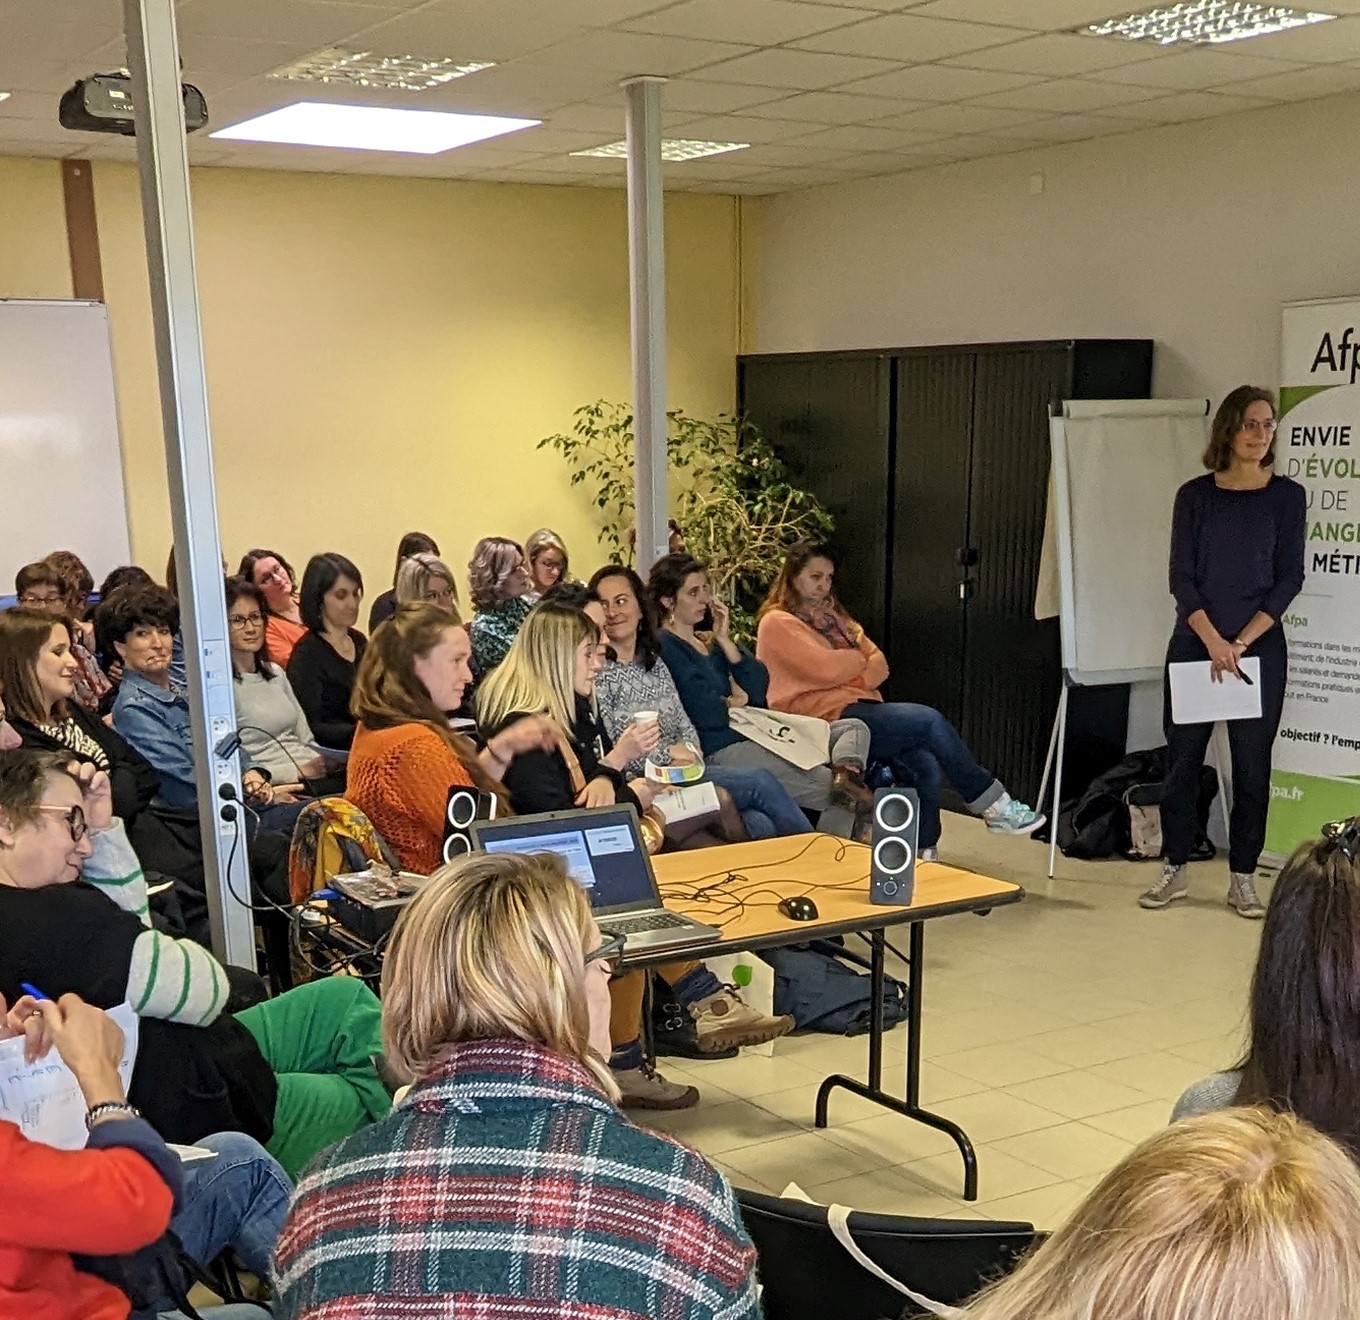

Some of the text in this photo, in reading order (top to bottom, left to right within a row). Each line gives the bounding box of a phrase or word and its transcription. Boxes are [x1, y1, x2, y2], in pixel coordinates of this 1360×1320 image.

[1290, 426, 1352, 446] ENVIE
[1321, 490, 1349, 511] DE
[1283, 613, 1308, 628] Afpa
[1280, 727, 1322, 743] objectif
[1324, 733, 1330, 744] ?
[1271, 783, 1305, 802] pa.fr
